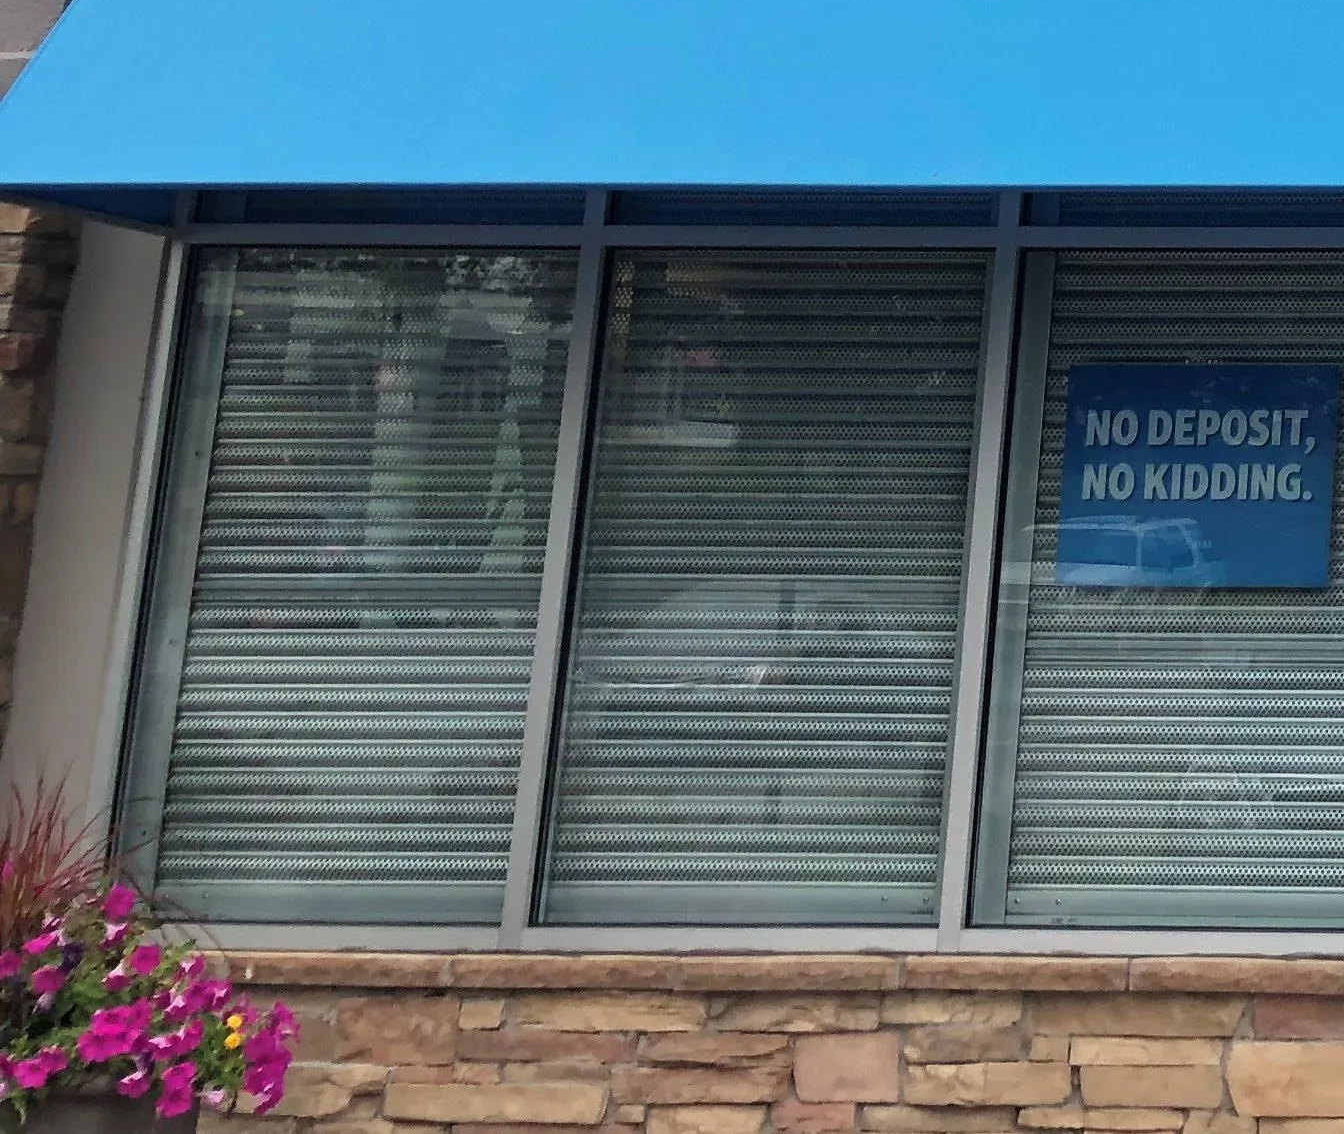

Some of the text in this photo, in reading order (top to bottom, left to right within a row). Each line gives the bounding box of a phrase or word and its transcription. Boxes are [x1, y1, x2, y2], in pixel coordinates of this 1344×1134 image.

[1084, 409, 1316, 455] NO DEPOSIT,
[1081, 464, 1313, 501] NO KIDDING.
